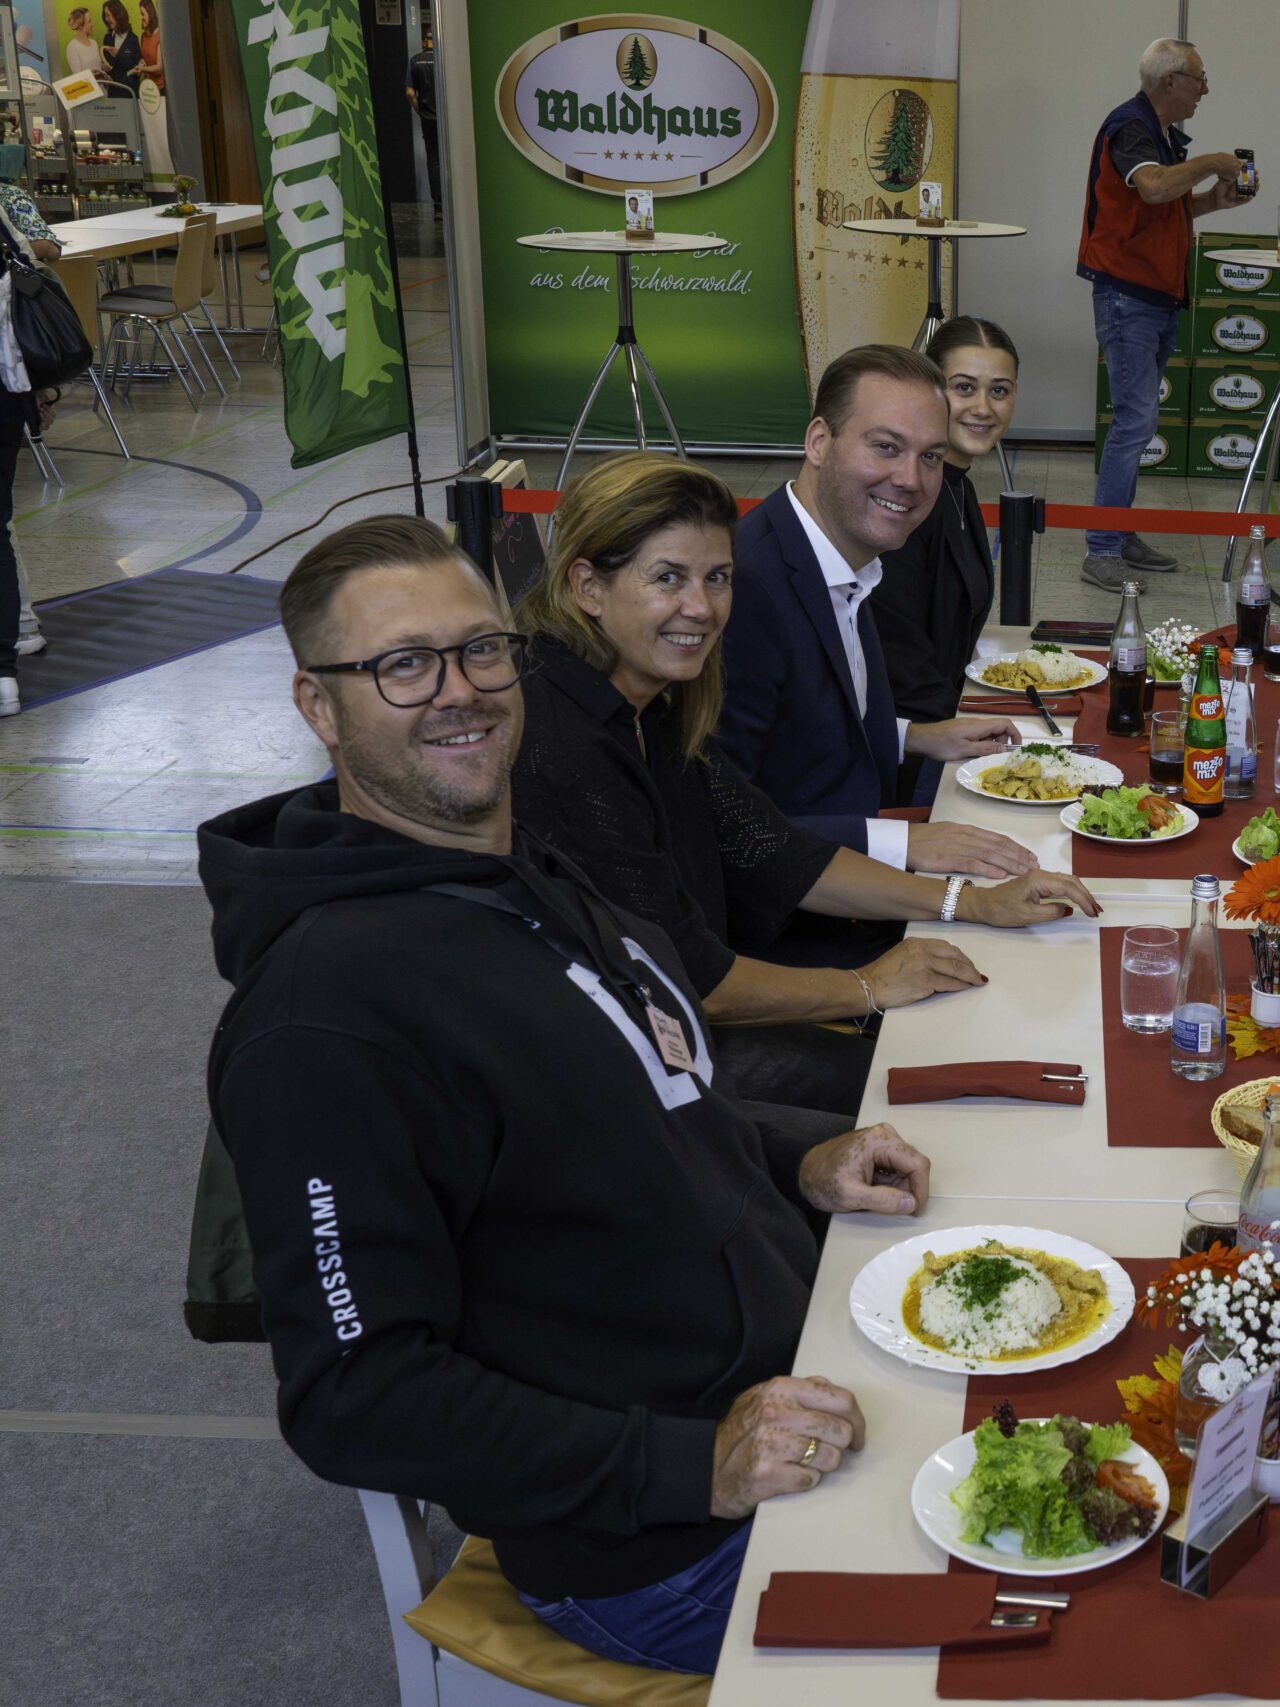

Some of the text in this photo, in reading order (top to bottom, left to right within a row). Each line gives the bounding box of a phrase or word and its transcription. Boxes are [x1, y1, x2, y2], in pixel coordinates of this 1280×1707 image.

[534, 87, 742, 145] Waldhaus
[530, 271, 564, 292] aus
[571, 265, 611, 293] dem
[1223, 268, 1265, 281] Waldhaus
[1219, 329, 1261, 342] Waldhaus
[1216, 388, 1258, 400] Waldhaus
[1213, 447, 1253, 460] Waldhau
[1199, 698, 1221, 710] mezzo
[1202, 707, 1216, 716] mix
[1193, 755, 1223, 771] mezzo
[1196, 766, 1217, 780] mix
[307, 1177, 363, 1341] CROSSCAMP
